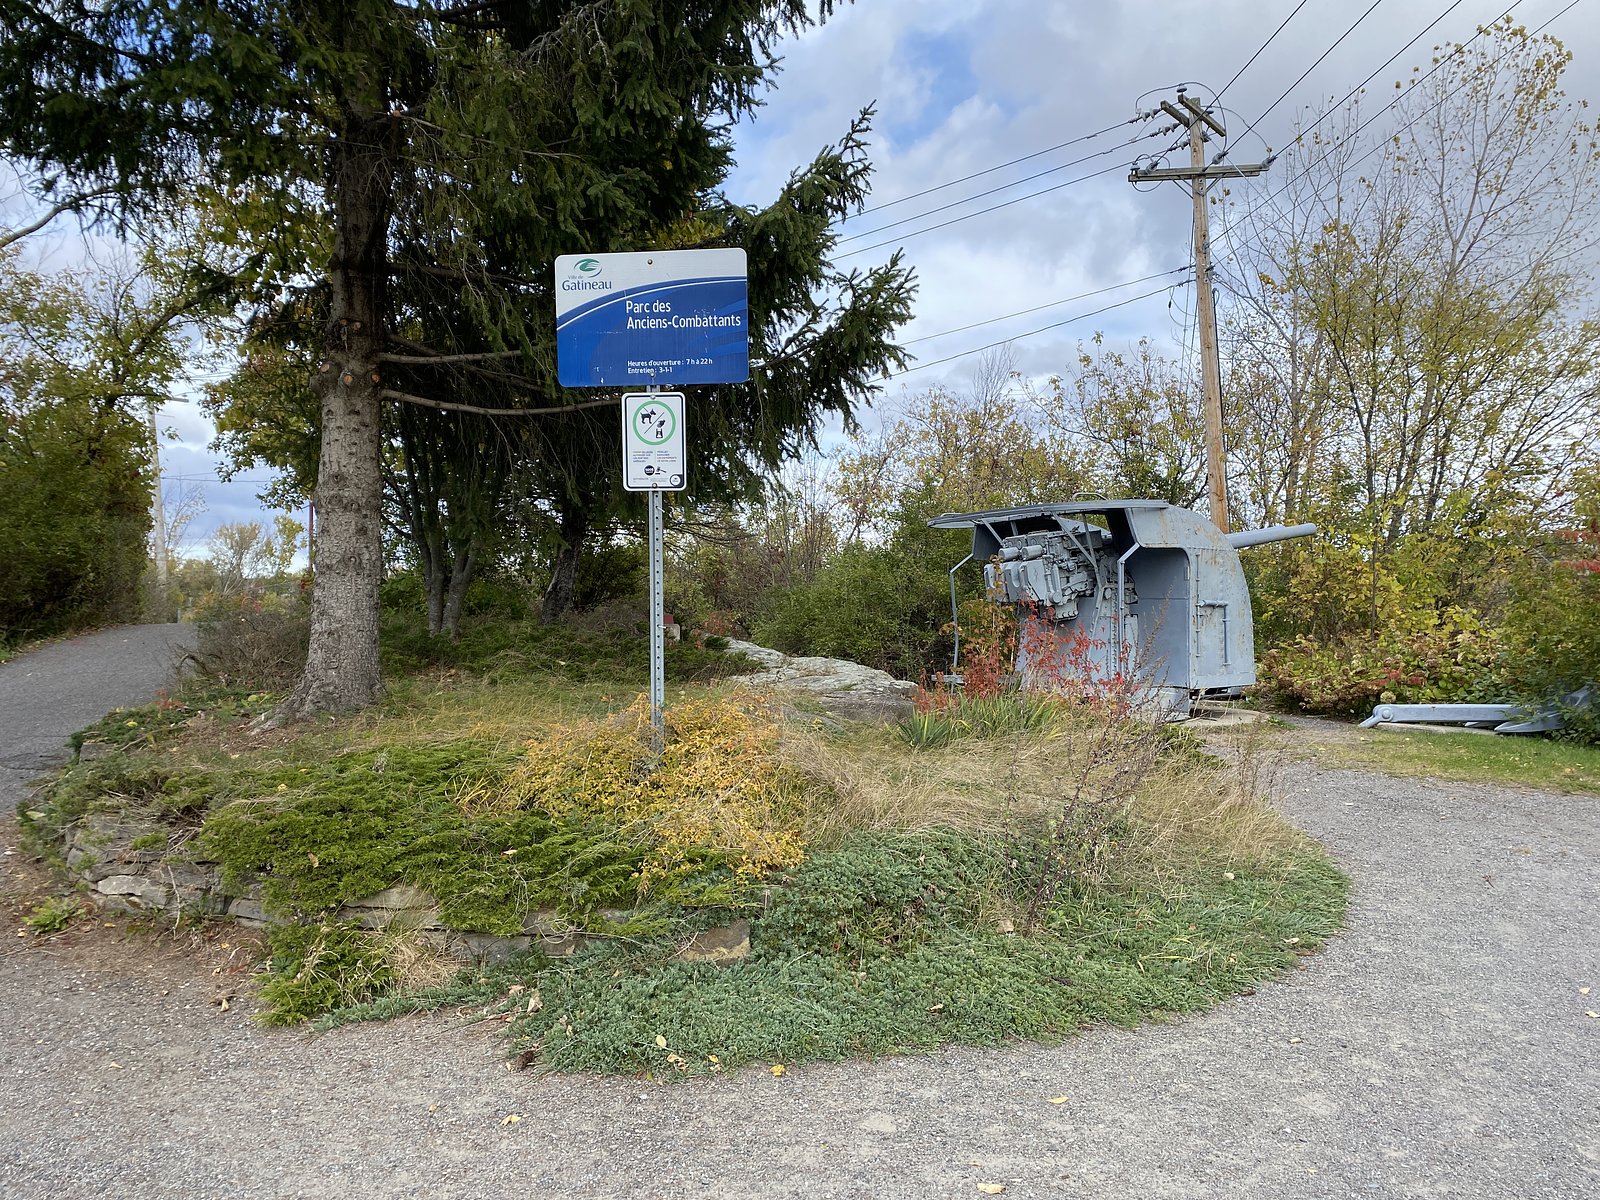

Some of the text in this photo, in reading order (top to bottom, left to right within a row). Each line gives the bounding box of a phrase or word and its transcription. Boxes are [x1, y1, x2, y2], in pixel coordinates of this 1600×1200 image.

[562, 280, 612, 291] Gatineau
[626, 300, 671, 313] Parc des
[627, 315, 741, 329] Anciens-Combattants
